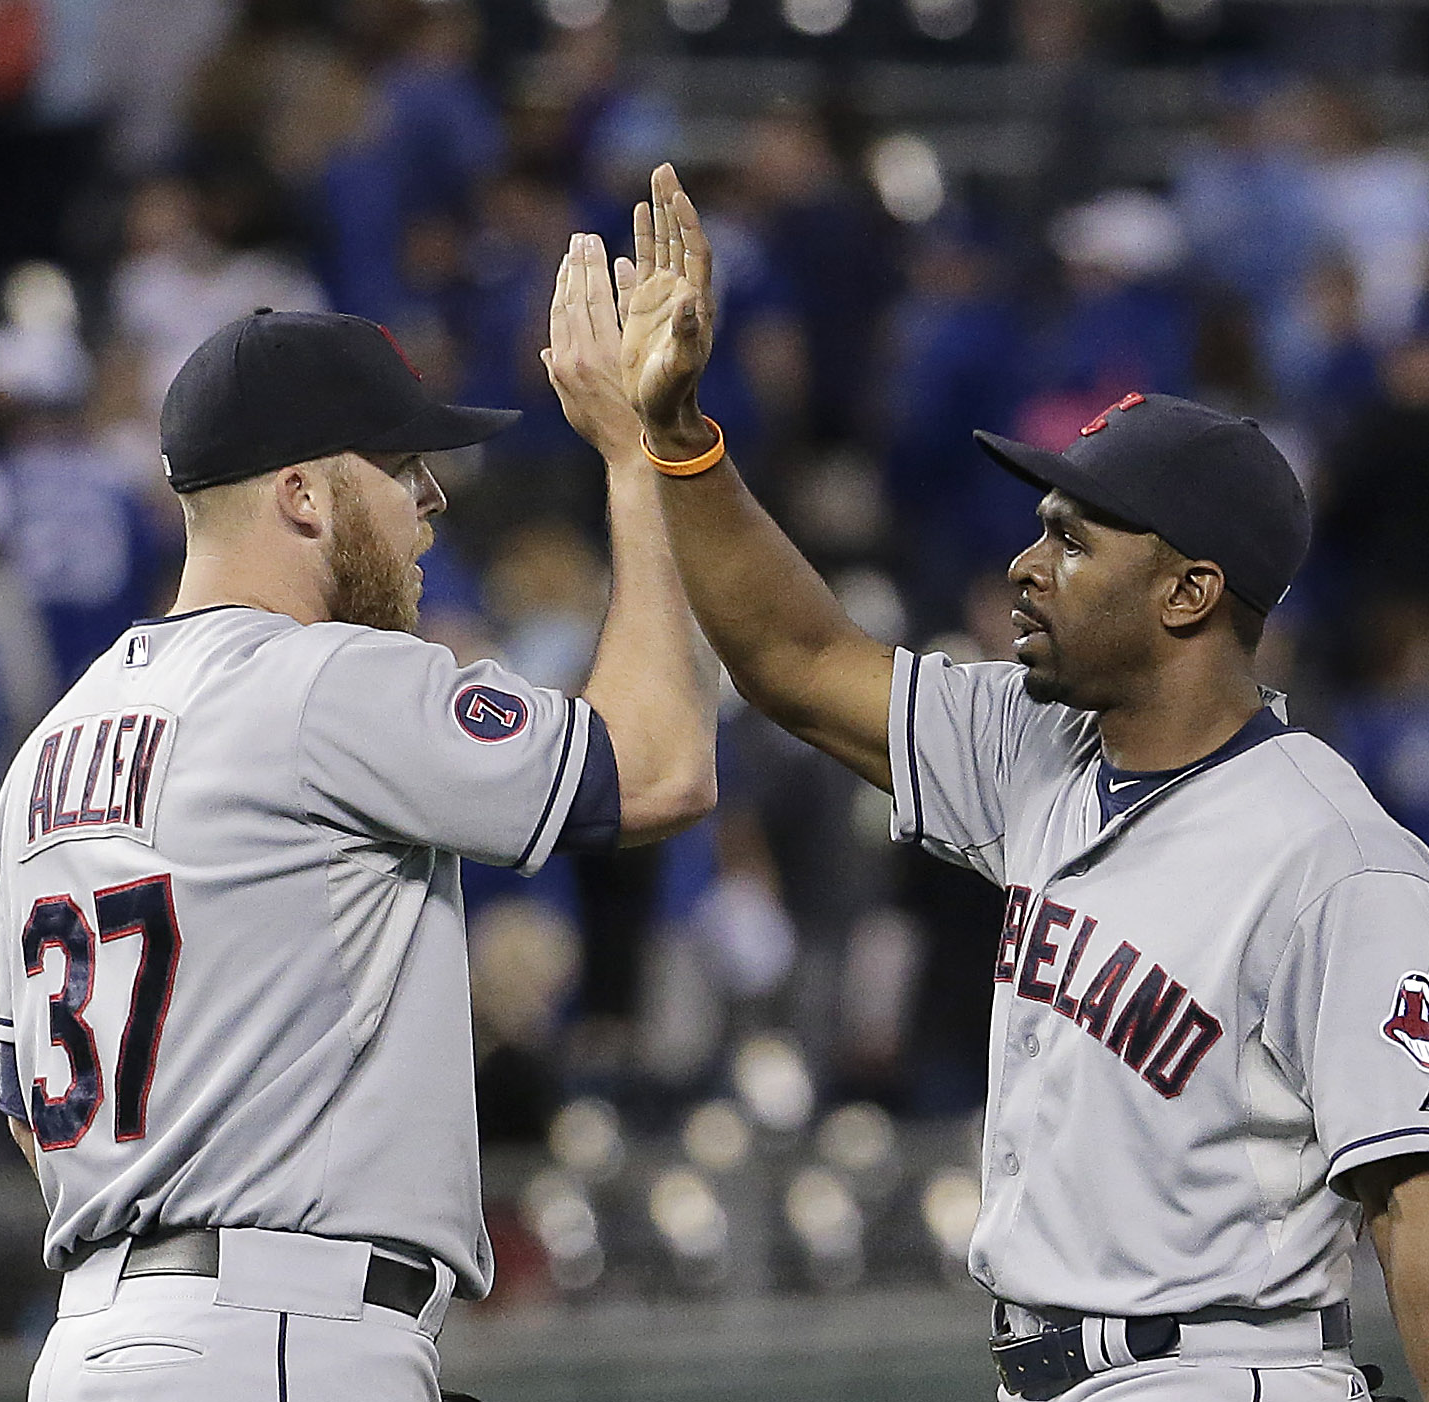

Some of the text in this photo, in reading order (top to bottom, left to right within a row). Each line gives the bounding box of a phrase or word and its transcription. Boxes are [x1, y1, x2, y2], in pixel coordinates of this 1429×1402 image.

[465, 693, 518, 729] 7
[27, 713, 167, 844] ALLEN
[22, 873, 182, 1152] 37
